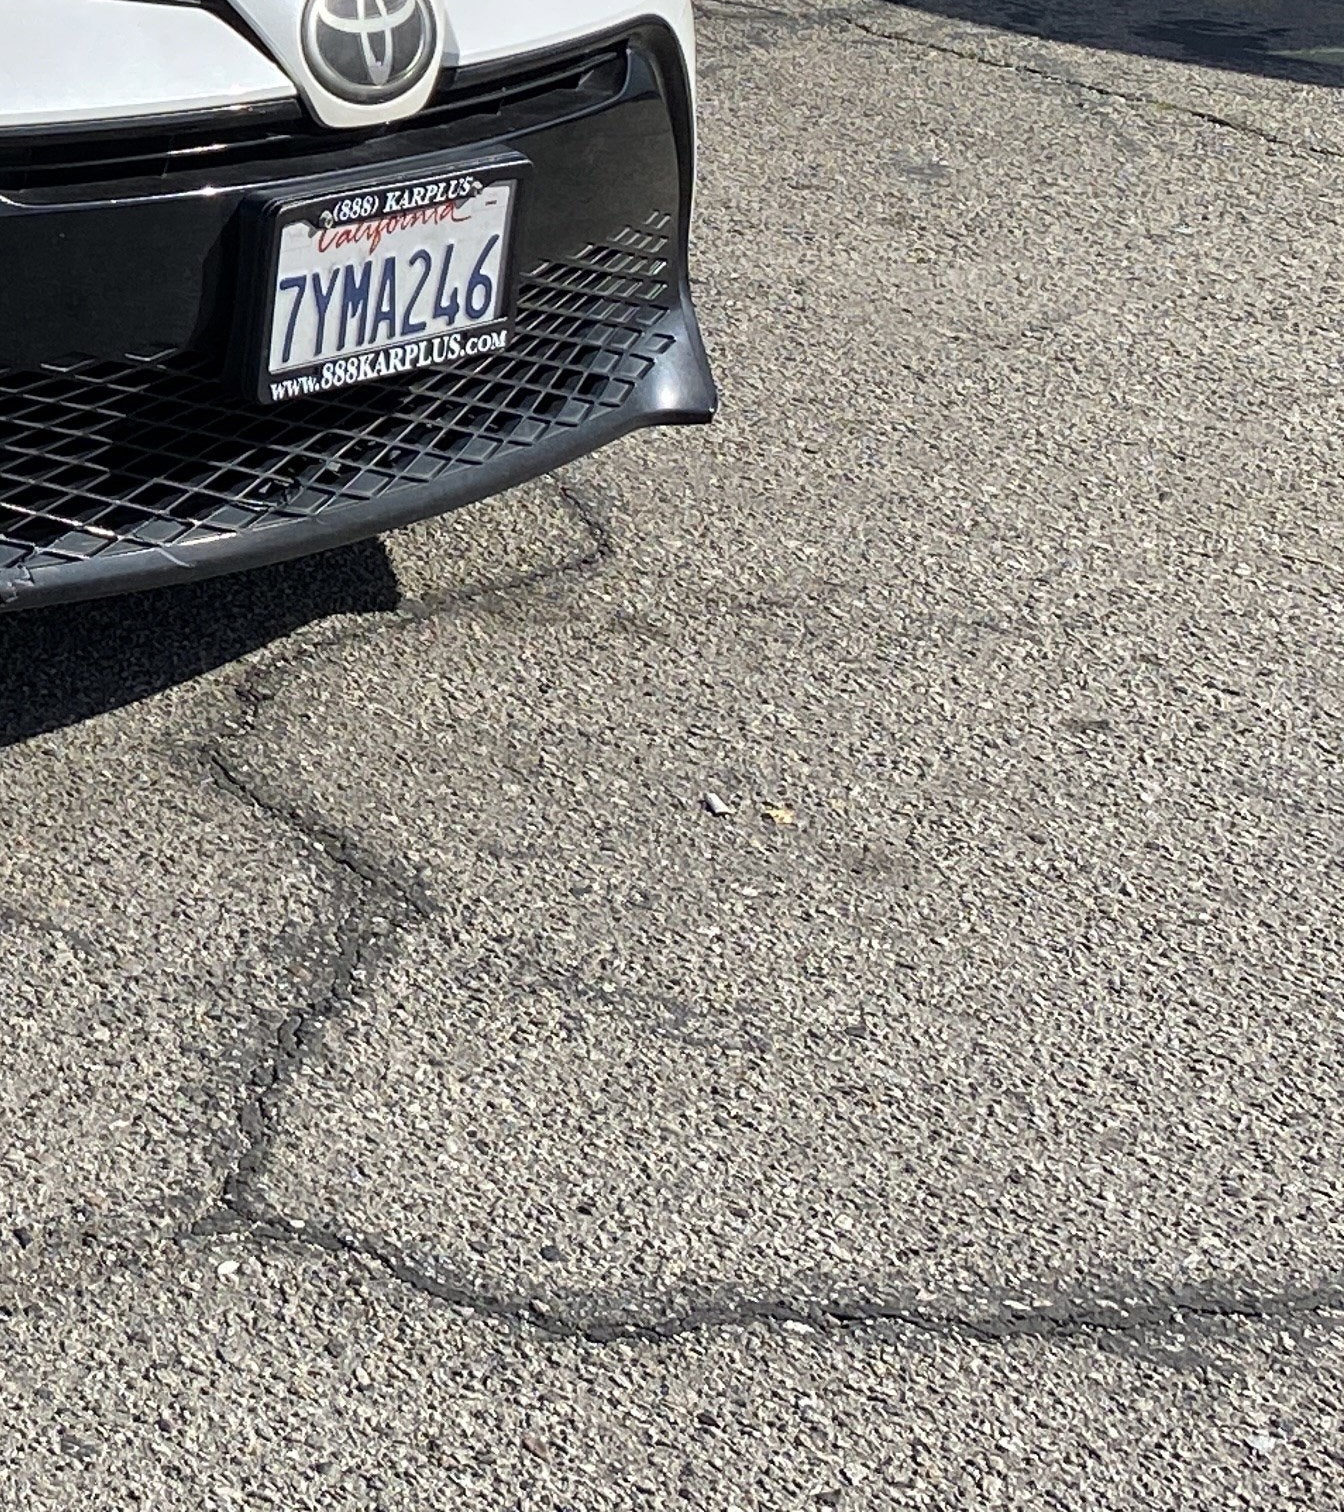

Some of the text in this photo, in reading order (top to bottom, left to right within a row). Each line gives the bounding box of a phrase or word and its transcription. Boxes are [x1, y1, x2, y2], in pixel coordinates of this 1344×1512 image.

[331, 175, 474, 224] (888) KARPLUS
[278, 233, 500, 363] 7YMA246
